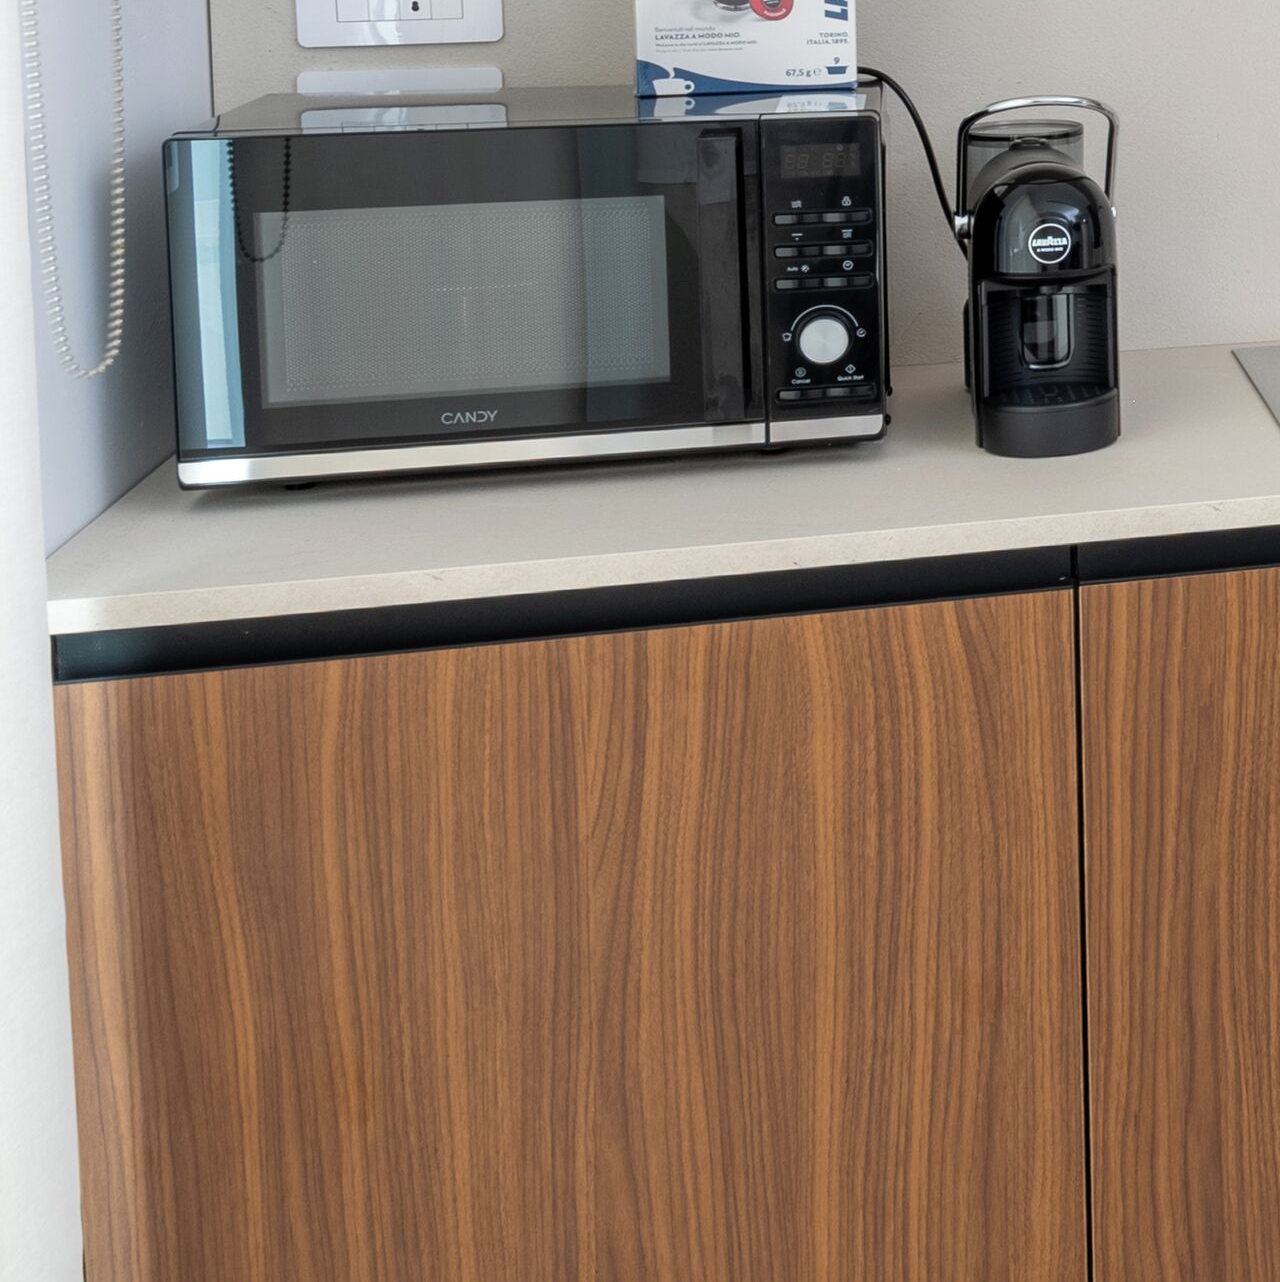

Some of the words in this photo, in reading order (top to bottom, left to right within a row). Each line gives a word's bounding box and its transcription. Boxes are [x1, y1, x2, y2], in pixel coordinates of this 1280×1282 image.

[833, 56, 840, 65] 9
[785, 68, 805, 77] 67,5
[805, 69, 812, 78] g
[1032, 236, 1067, 246] LAVAZZA
[441, 409, 498, 425] CANDY
